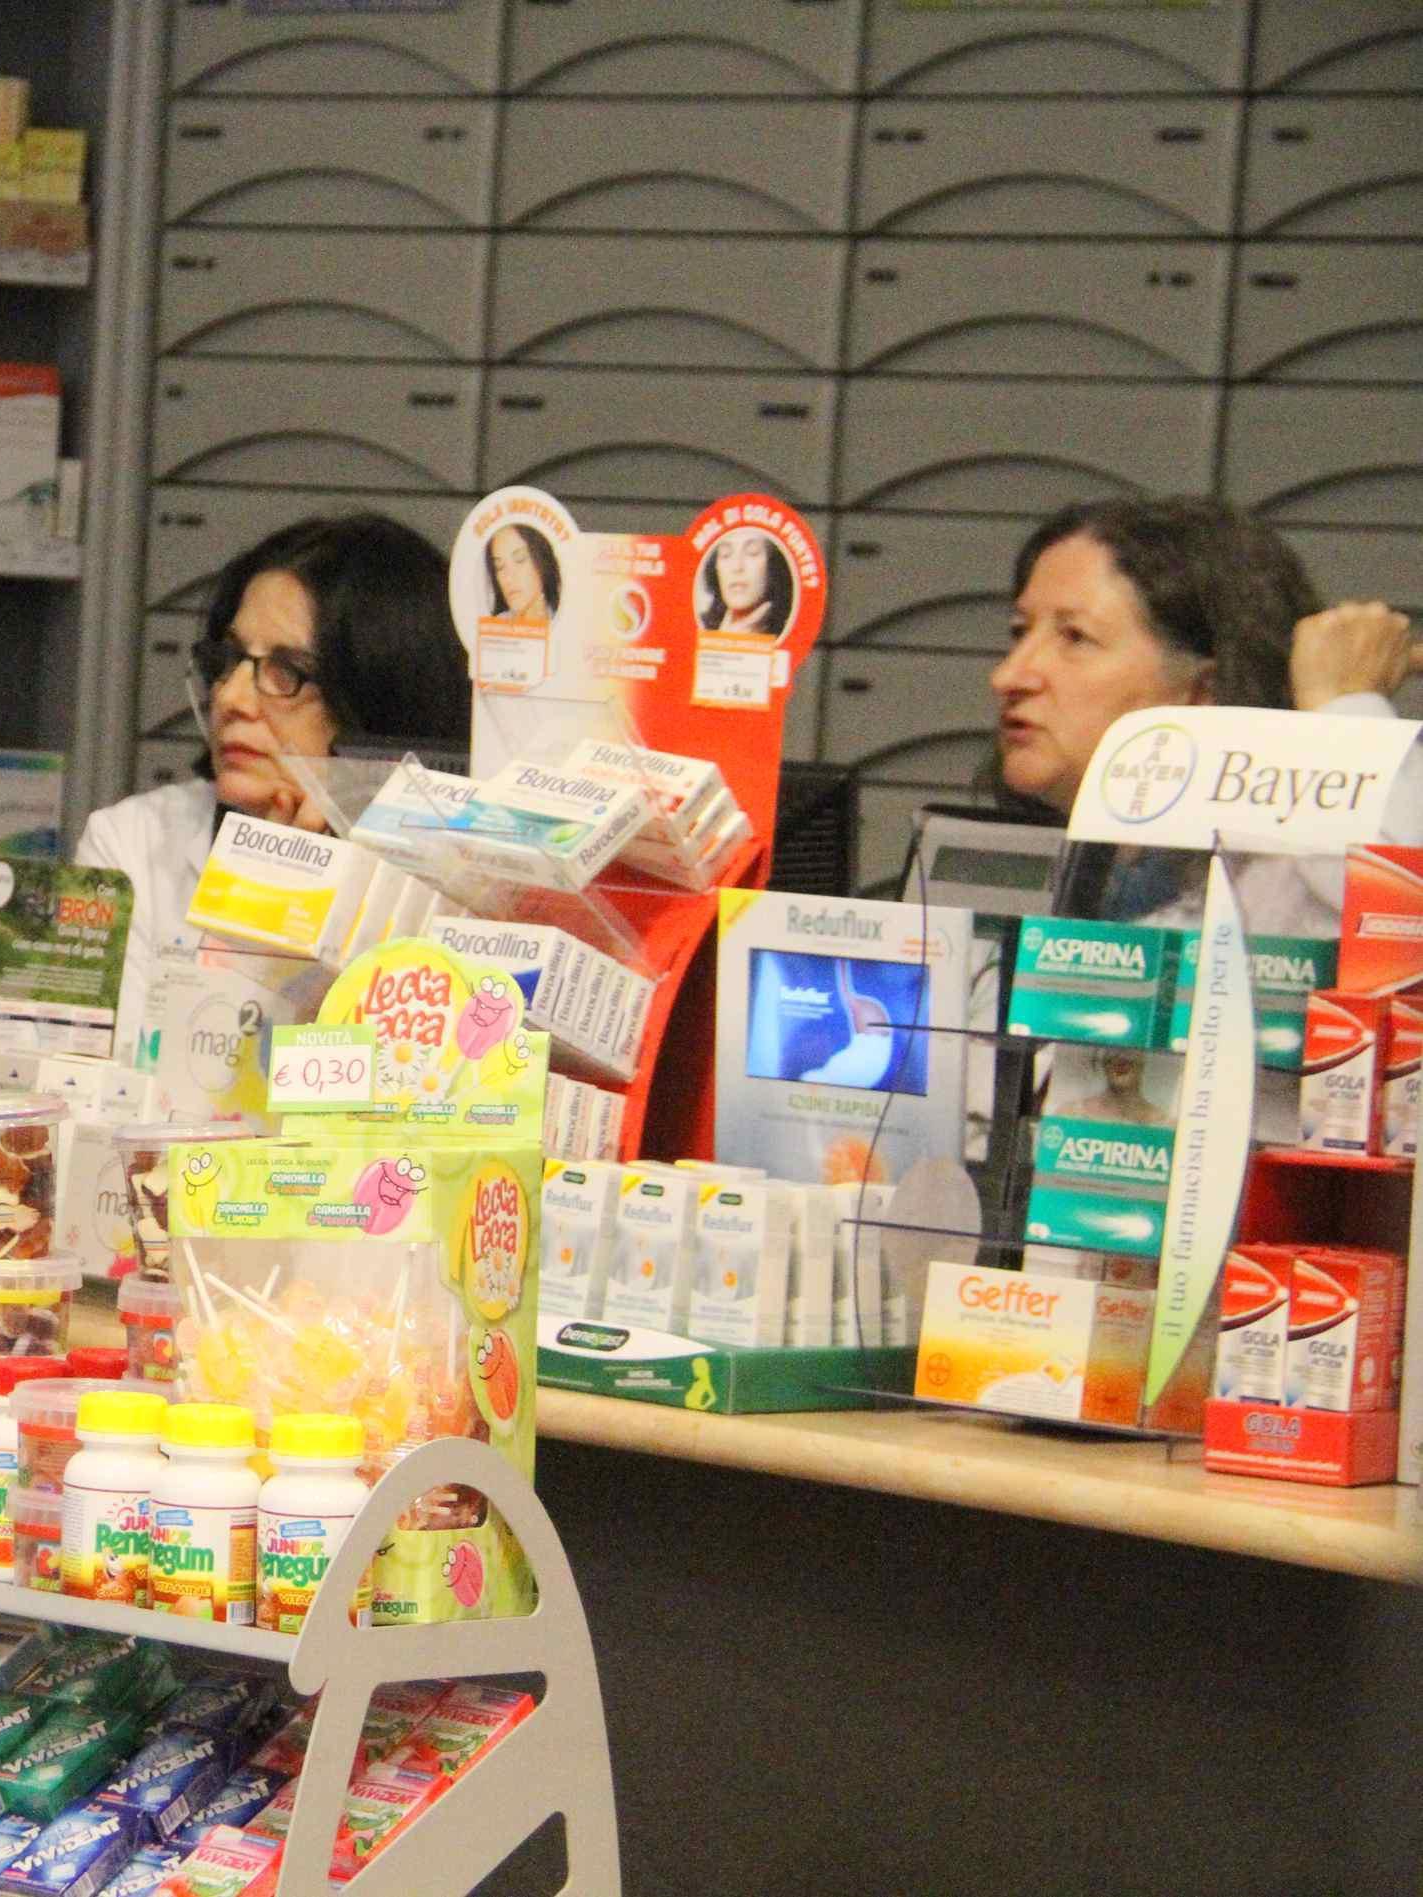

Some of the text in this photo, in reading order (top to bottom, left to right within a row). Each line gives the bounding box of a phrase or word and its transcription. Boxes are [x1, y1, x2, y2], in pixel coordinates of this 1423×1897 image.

[742, 504, 783, 529] GOLA
[592, 745, 685, 777] Borocillina
[1110, 763, 1186, 781] BAYER
[515, 767, 618, 802] Borocillina
[1207, 749, 1377, 824] Bayer
[232, 821, 333, 868] Borocillina
[578, 805, 642, 867] Borocillina
[786, 904, 884, 940] Reduflux
[1213, 923, 1233, 945] te
[440, 927, 541, 961] Borocillina
[1038, 938, 1147, 969] ASPIRINA
[364, 964, 452, 1015] Lecca
[539, 940, 567, 1010] Borocillina
[560, 952, 588, 1022] Borocillina
[1210, 959, 1230, 997] per
[580, 963, 608, 1034] Borocillina
[599, 974, 627, 1046] Borocillina
[190, 1030, 242, 1067] mag
[1198, 1005, 1221, 1079] scelto
[273, 1058, 365, 1094] € 0,30
[1324, 1074, 1366, 1089] GOLA
[1189, 1089, 1212, 1118] ha
[1058, 1137, 1170, 1171] ASPIRINA
[270, 1173, 327, 1186] CAMOMILLA
[1172, 1127, 1207, 1261] farmacista
[97, 1190, 130, 1216] ma
[216, 1203, 268, 1216] CAMOMILLA
[313, 1204, 372, 1217] CAMOMILLA
[474, 1175, 520, 1227] Lecca
[470, 1213, 519, 1264] Lecca
[957, 1275, 1062, 1319] Geffer
[1097, 1296, 1147, 1320] Geffer
[1170, 1271, 1191, 1312] tuo
[1240, 1330, 1280, 1347] GOLA
[1308, 1341, 1347, 1359] GOLA
[1244, 1411, 1302, 1439] GOLA
[95, 1523, 152, 1556] Bene
[120, 1515, 152, 1532] JUN
[267, 1537, 324, 1555] JUNIOR
[261, 1551, 330, 1587] enegu
[371, 1600, 418, 1617] enegum
